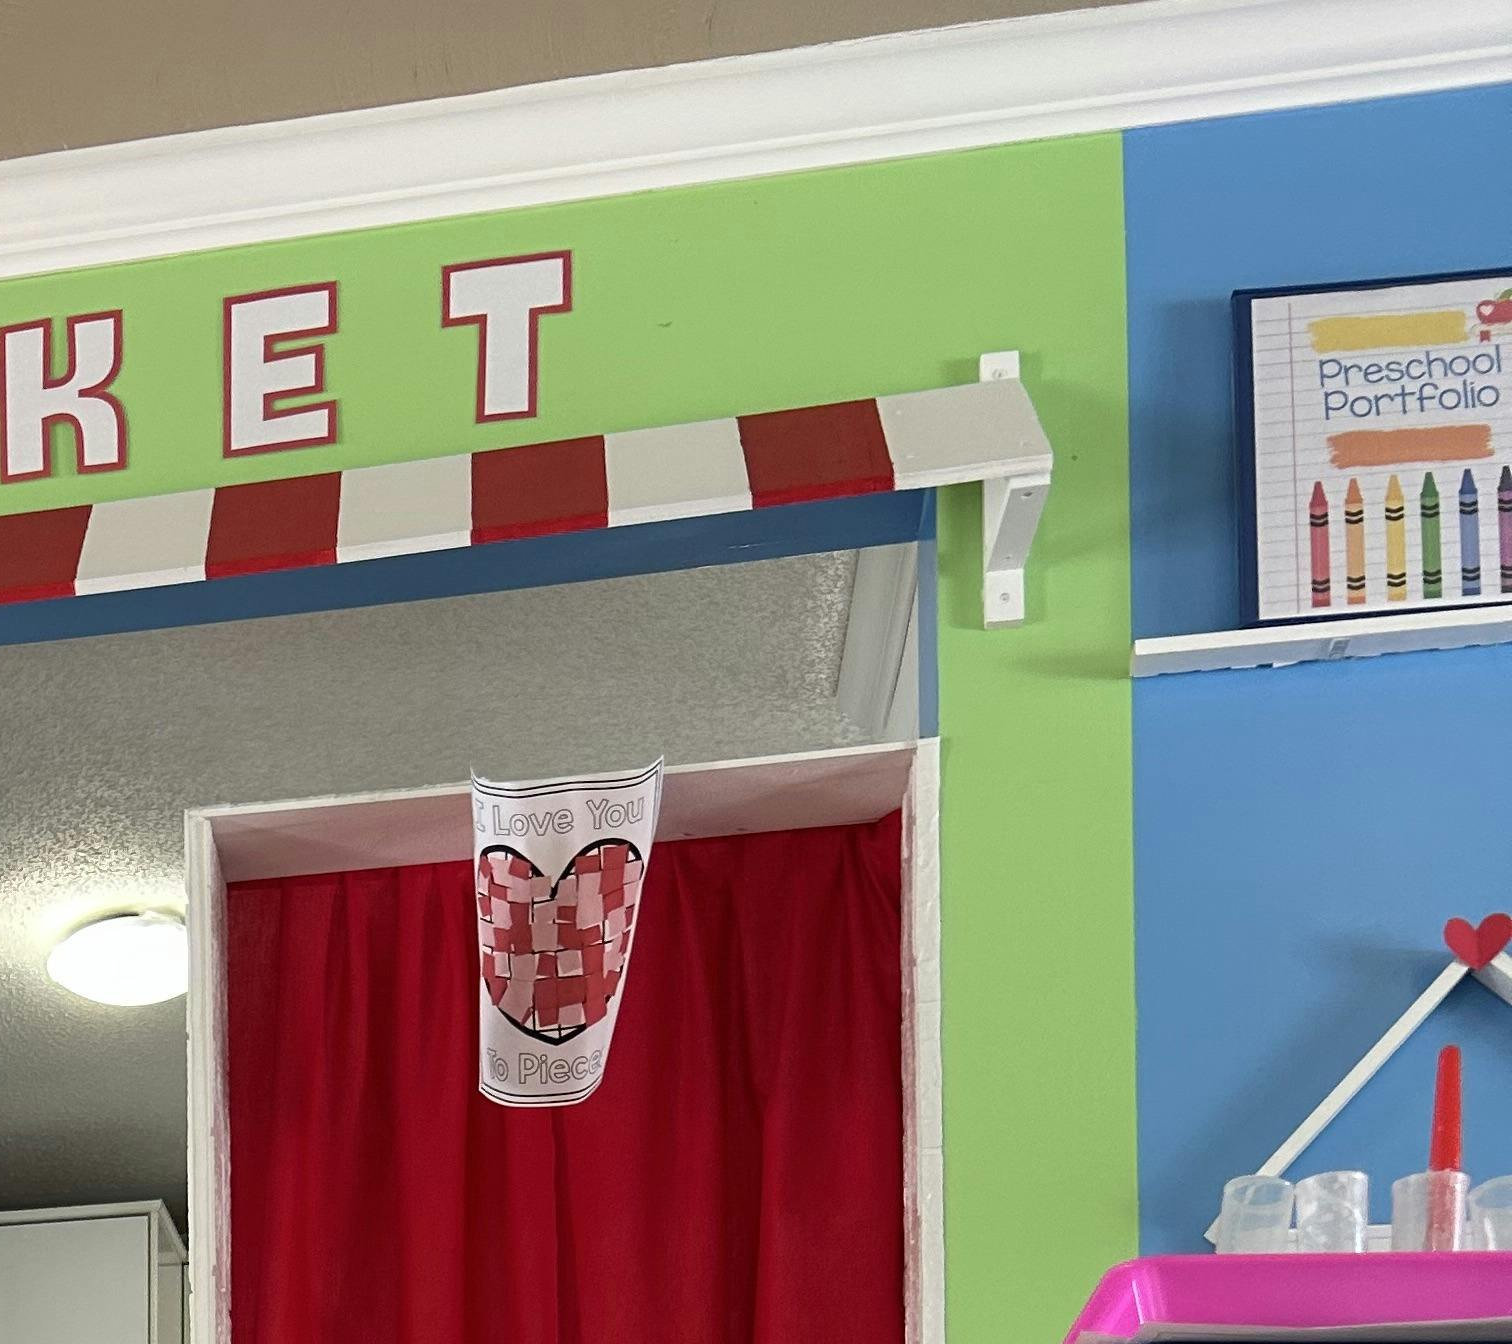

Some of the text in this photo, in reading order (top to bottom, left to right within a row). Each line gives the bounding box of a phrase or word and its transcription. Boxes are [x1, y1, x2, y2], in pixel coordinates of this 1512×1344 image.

[1319, 344, 1502, 388] Preschool
[1324, 378, 1500, 420] Portfolio
[492, 804, 574, 836] Love
[586, 796, 645, 830] You
